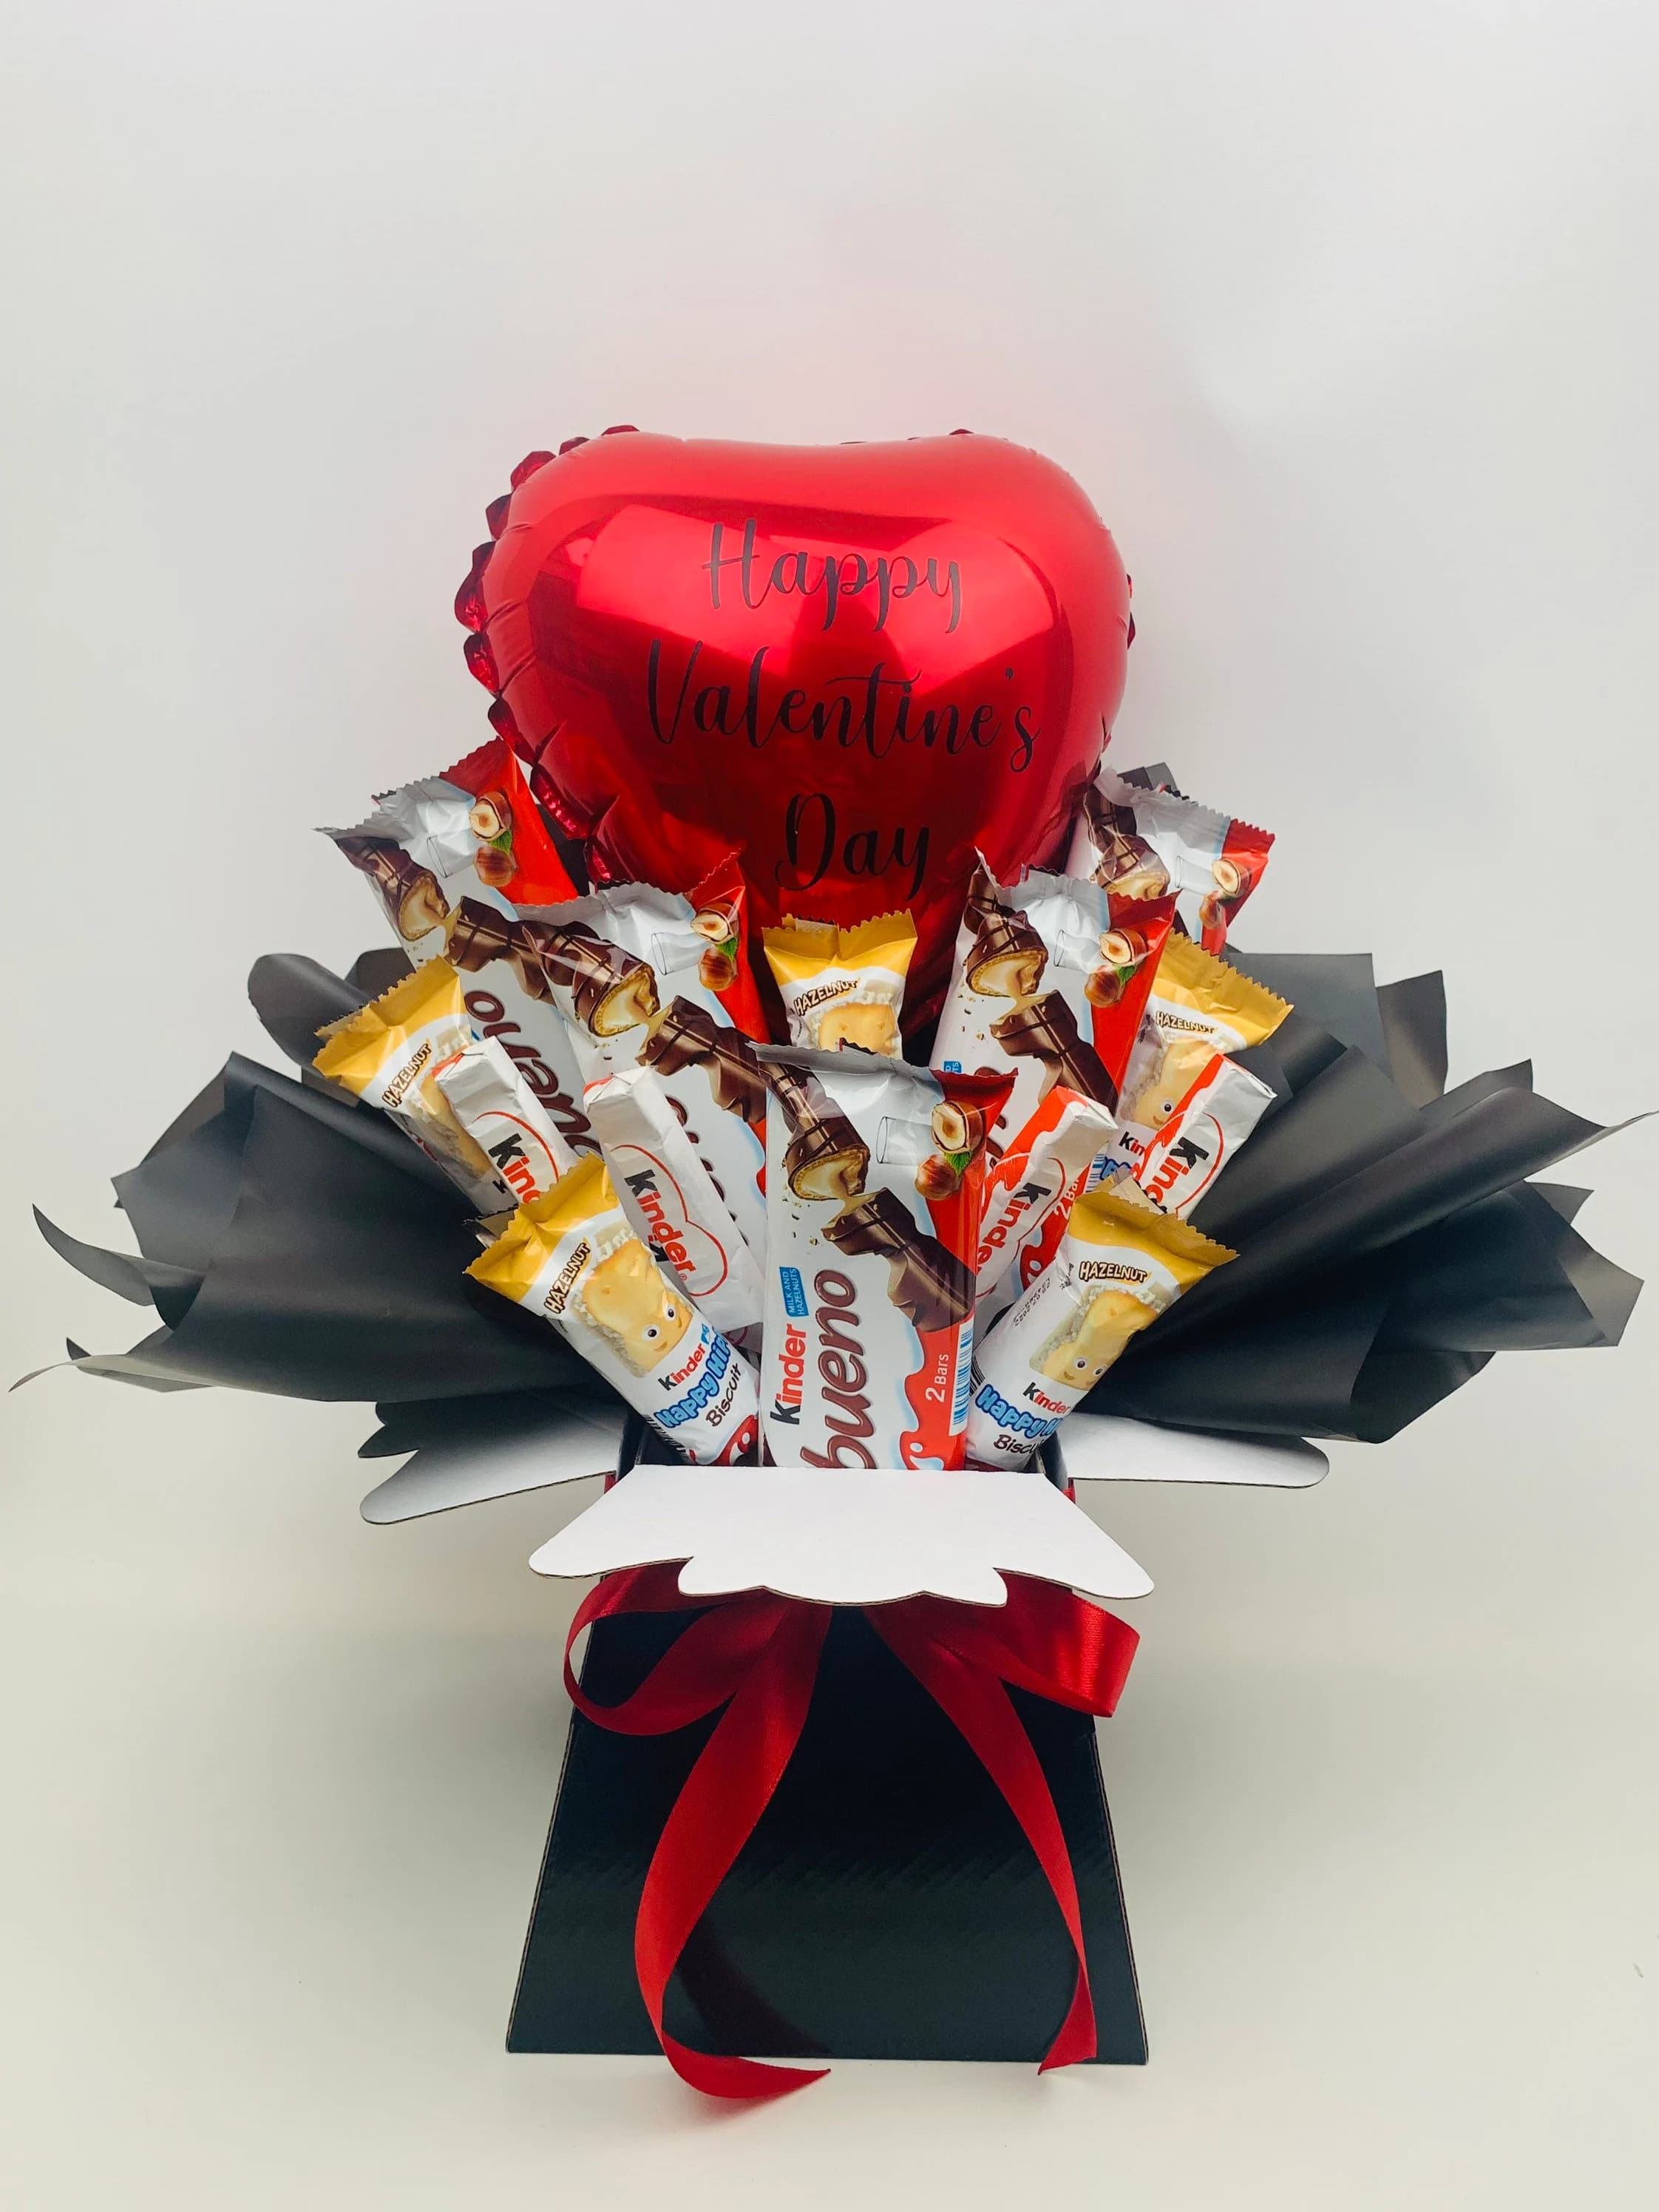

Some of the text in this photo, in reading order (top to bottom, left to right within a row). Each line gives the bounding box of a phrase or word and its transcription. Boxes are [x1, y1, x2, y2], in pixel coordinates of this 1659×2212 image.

[702, 519, 961, 634] Happy
[647, 639, 1040, 773] Valentine's
[775, 793, 929, 900] Day
[794, 980, 858, 1016] HAZELNUT
[1156, 1011, 1215, 1034] HAZELNUT
[382, 1042, 432, 1107] HAZELNUT
[624, 1169, 696, 1272] Kinder
[976, 1182, 1052, 1275] Kinde
[1054, 1201, 1071, 1220] 2
[543, 1242, 591, 1314] HAZELNUT
[782, 1271, 796, 1314] MILK AND
[790, 1269, 805, 1315] HAZELNUTS
[1079, 1261, 1148, 1283] HAZELNUT
[657, 1343, 706, 1391] Kinder
[706, 1363, 742, 1427] Biscuit
[770, 1323, 807, 1425] Kinder
[800, 1269, 878, 1469] bueno
[925, 1353, 949, 1403] 2 Bars
[654, 1371, 720, 1428] Happy
[975, 1384, 1048, 1439] Happy
[1022, 1382, 1071, 1414] Kinder
